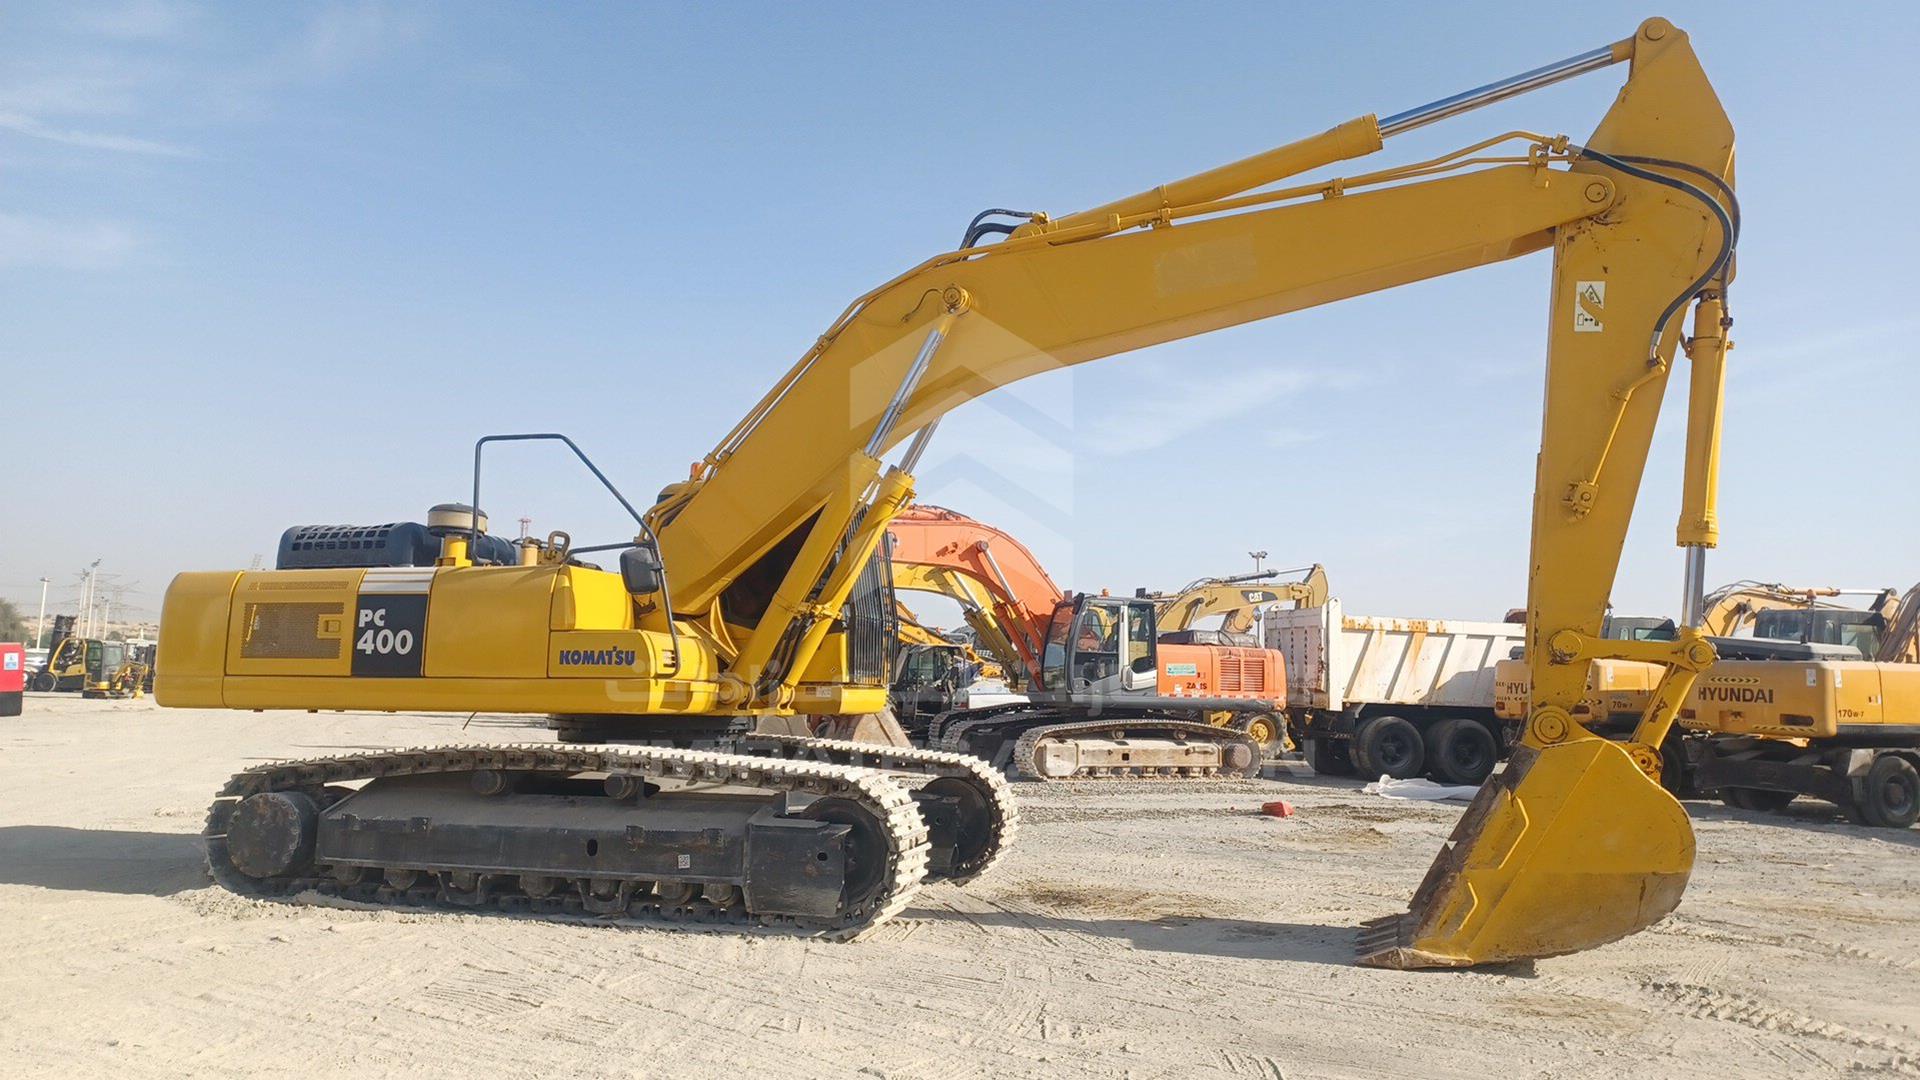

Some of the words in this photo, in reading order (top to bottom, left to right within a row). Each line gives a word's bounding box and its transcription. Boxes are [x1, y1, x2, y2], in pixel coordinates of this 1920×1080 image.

[1248, 591, 1263, 603] CAT
[358, 608, 386, 628] PC
[356, 628, 414, 655] 400
[559, 646, 636, 666] KOMATSU
[1698, 686, 1774, 704] HYUNDAI
